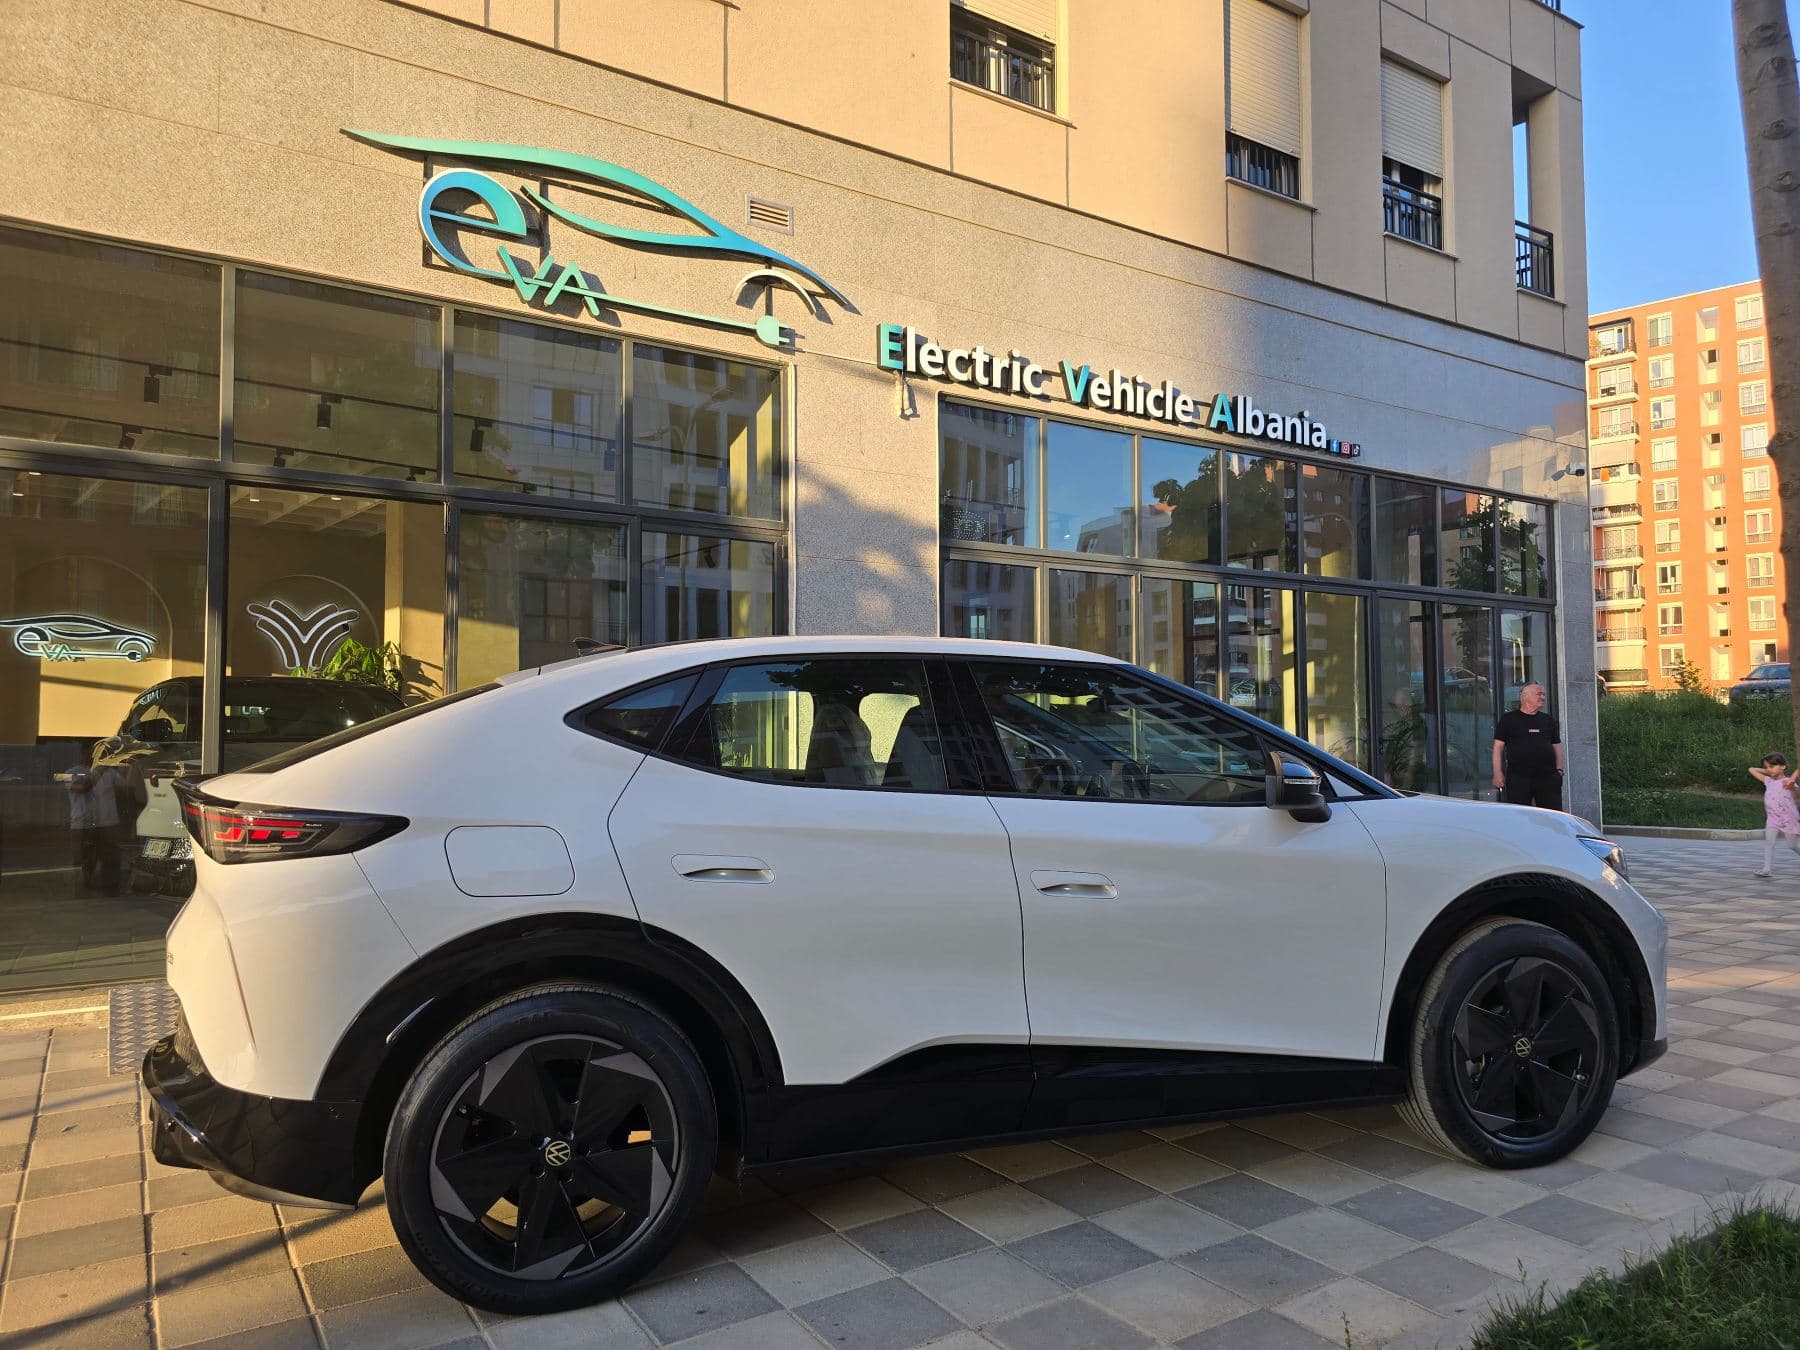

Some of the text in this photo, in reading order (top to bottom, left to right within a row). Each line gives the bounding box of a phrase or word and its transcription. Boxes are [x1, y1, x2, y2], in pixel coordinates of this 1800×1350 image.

[876, 322, 1327, 449] Electric Vehicle Albania
